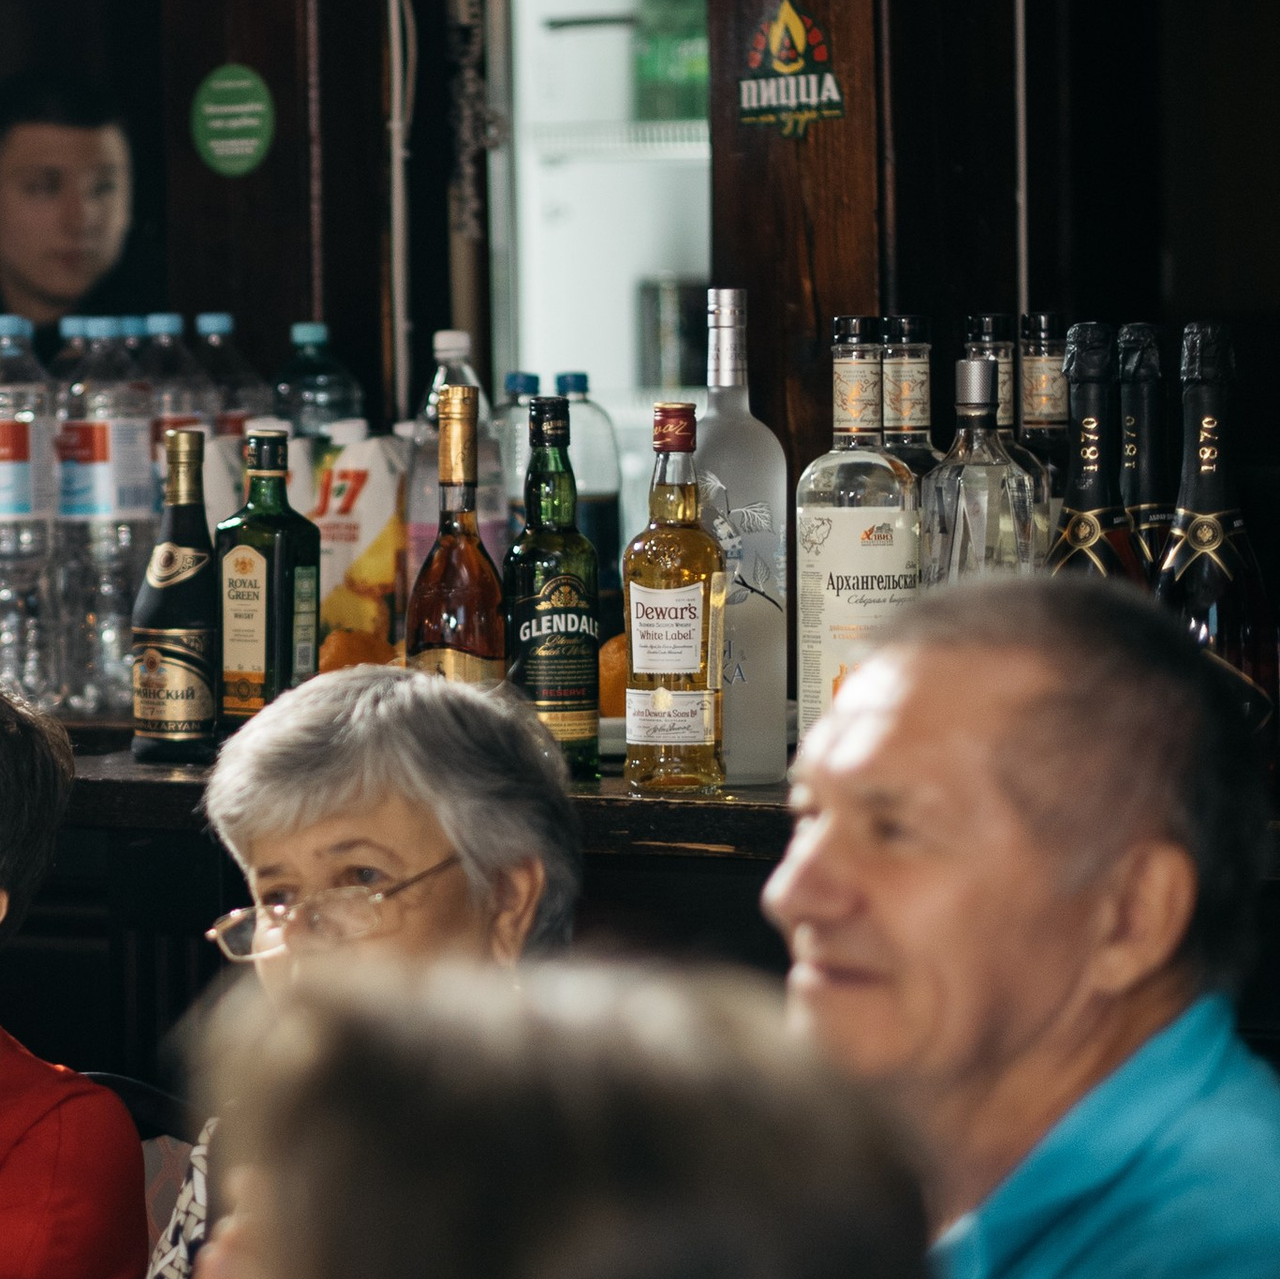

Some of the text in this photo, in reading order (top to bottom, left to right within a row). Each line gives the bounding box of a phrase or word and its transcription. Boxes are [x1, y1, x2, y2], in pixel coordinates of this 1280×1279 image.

[740, 72, 841, 110] ПИЦЦА
[1081, 417, 1099, 472] 1870
[1124, 416, 1137, 468] 1870
[1199, 417, 1218, 472] 1870
[227, 578, 261, 590] ROYAL
[227, 589, 260, 601] GREEN
[635, 602, 698, 621] Dewar's
[541, 688, 587, 697] RESERVE
